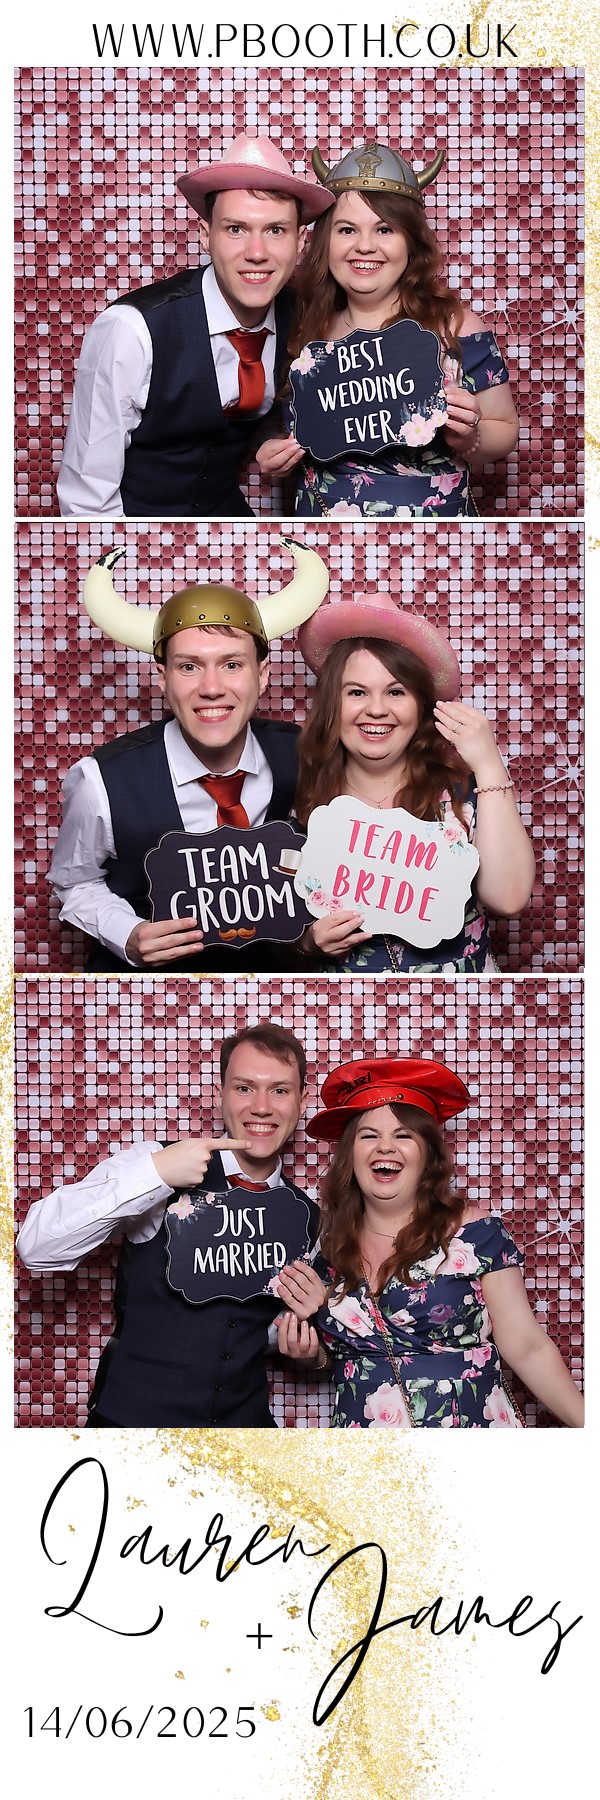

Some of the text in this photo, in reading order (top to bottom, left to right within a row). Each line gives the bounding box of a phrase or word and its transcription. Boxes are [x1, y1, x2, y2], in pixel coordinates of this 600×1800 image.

[337, 337, 383, 373] BEST
[317, 368, 415, 412] WEDDING
[344, 409, 398, 444] EVER
[177, 842, 269, 888] TEAM
[348, 818, 439, 871] TEAM
[170, 880, 296, 933] GROOM
[332, 864, 440, 922] BRIDE
[213, 1204, 267, 1239] JUST
[193, 1241, 287, 1277] MARRIED
